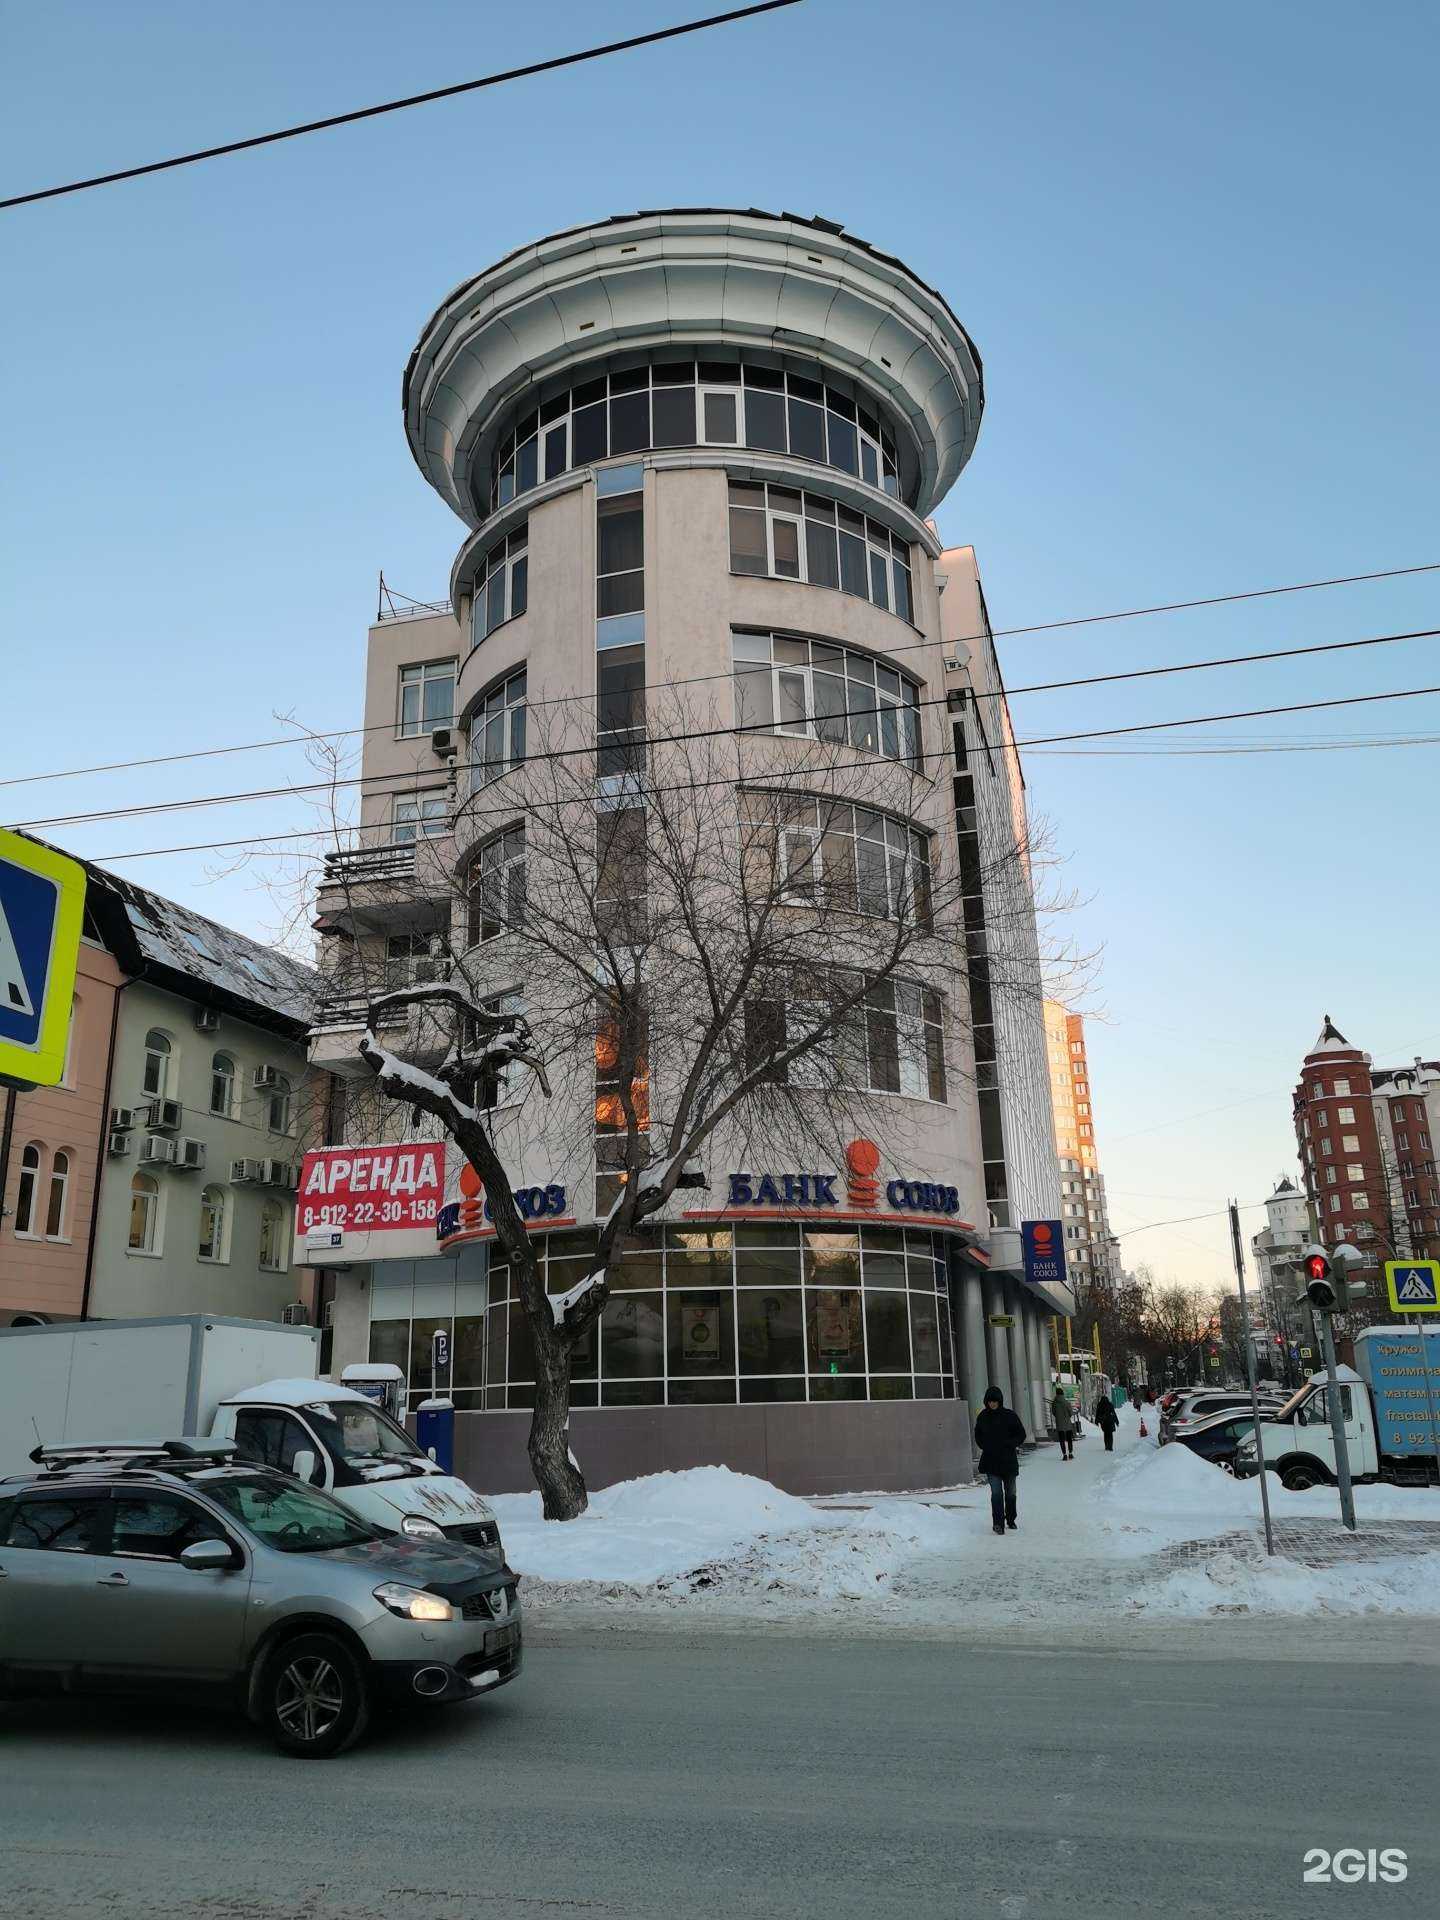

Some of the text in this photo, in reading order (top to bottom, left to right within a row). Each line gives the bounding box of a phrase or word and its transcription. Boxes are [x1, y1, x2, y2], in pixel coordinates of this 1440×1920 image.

[304, 1152, 438, 1196] АРЕНДА
[728, 1173, 960, 1215] БАНК СОЮЗ
[303, 1199, 437, 1227] 8-912-22-30-158
[1033, 1262, 1057, 1270] БАНК
[1033, 1269, 1058, 1277] СОЮЗ
